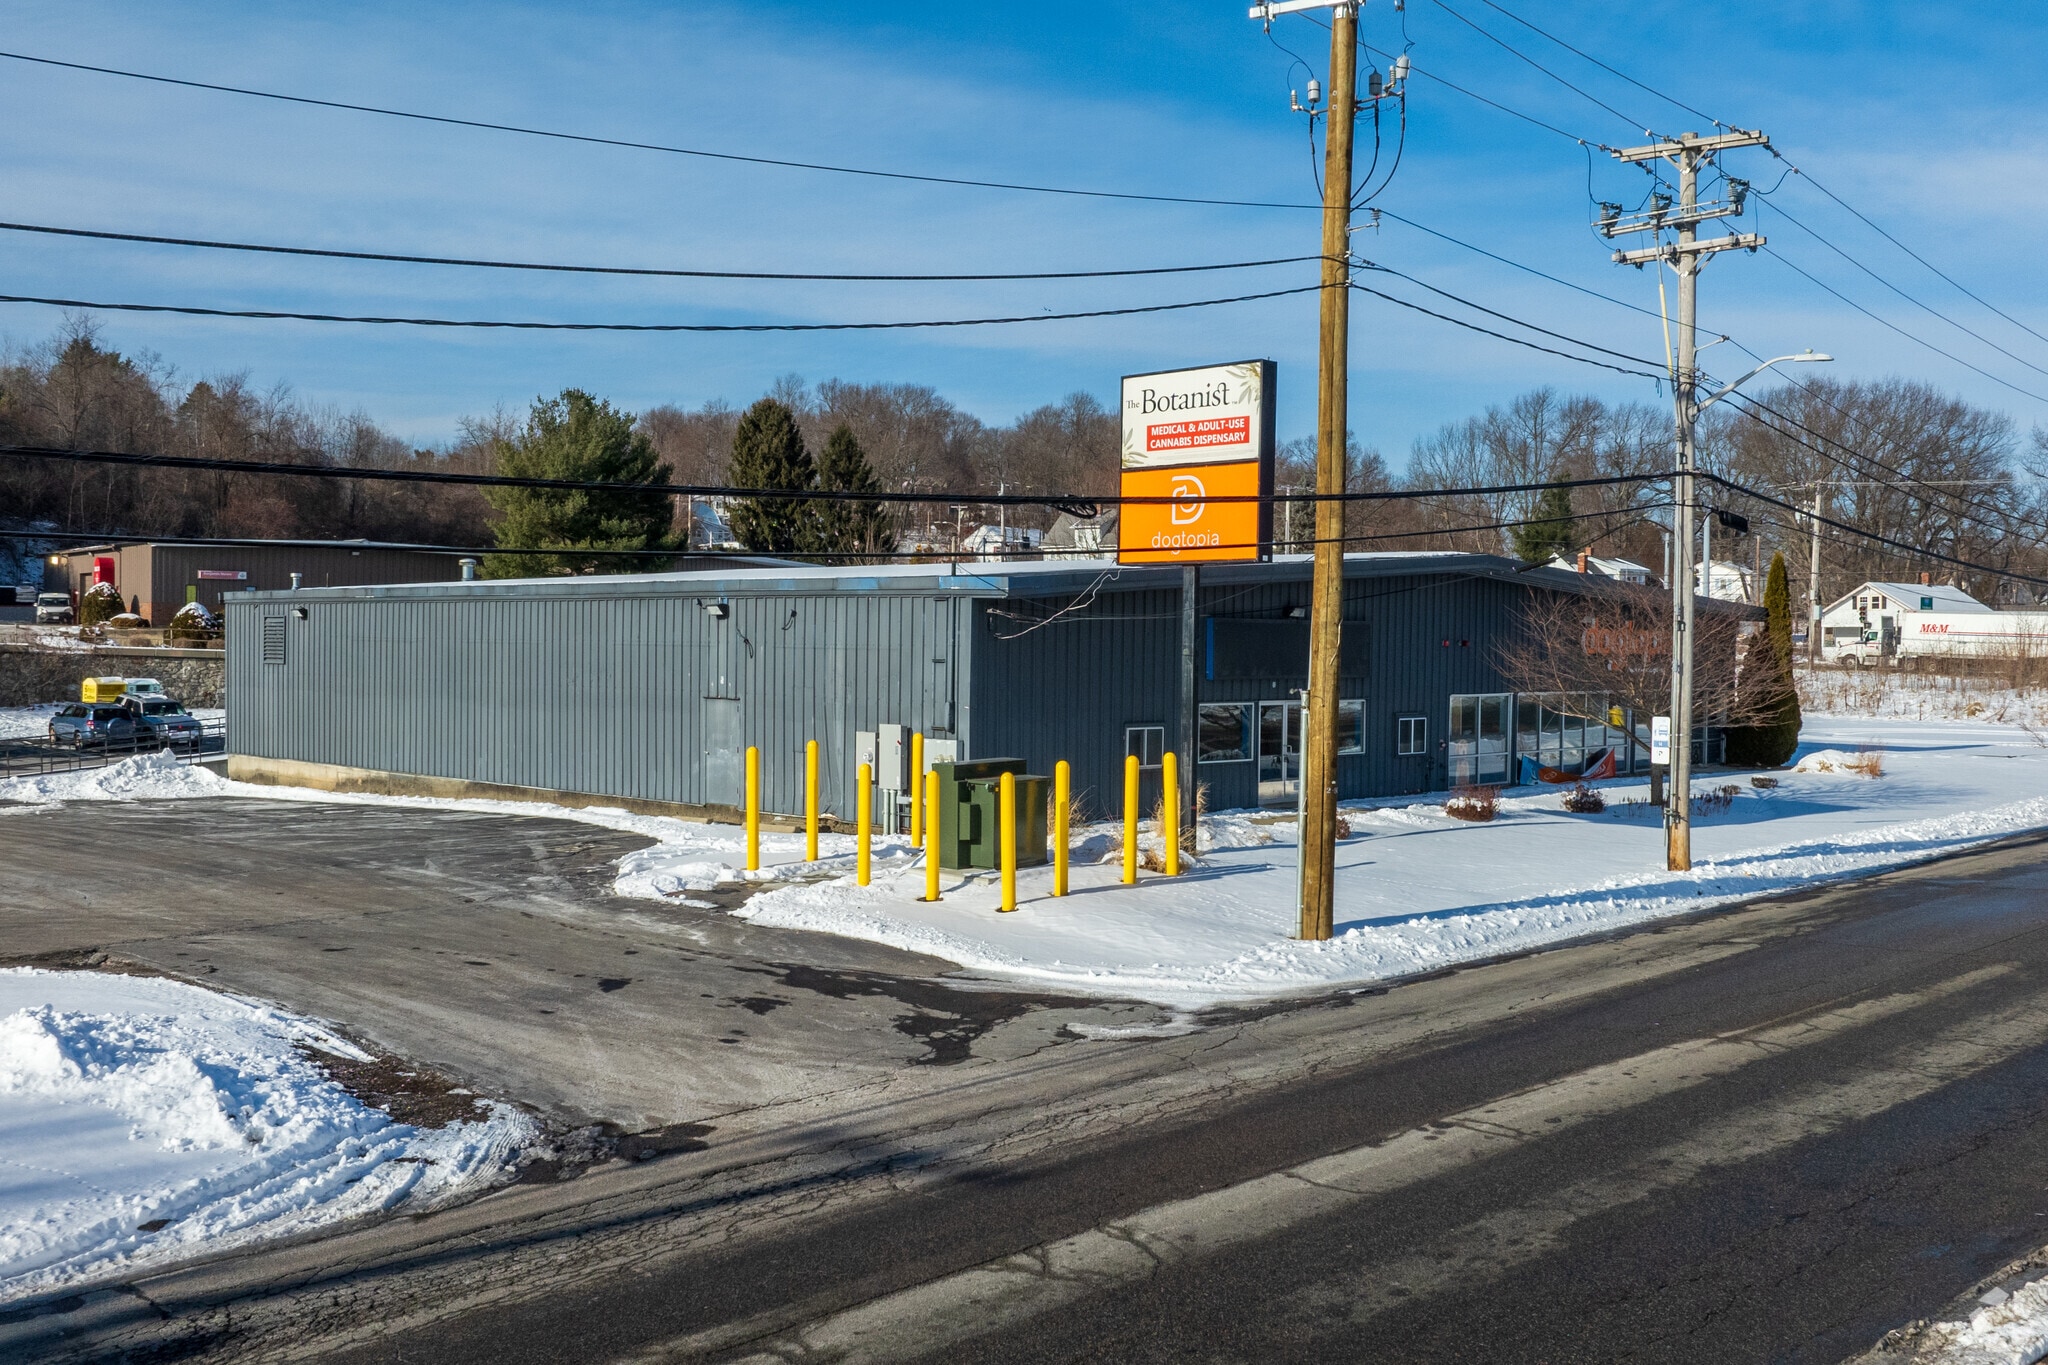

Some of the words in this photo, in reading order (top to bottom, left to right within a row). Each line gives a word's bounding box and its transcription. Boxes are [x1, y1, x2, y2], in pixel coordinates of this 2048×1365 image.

[1126, 400, 1140, 409] The
[1141, 382, 1230, 414] Botanist
[1151, 424, 1187, 436] MEDICAL
[1188, 423, 1196, 433] &
[1198, 418, 1245, 432] ADULT-USE
[1150, 436, 1192, 449] CANNABIS
[1194, 431, 1246, 445] DISPENSARY
[1152, 530, 1220, 555] dogtopia
[1920, 624, 1949, 633] M&M
